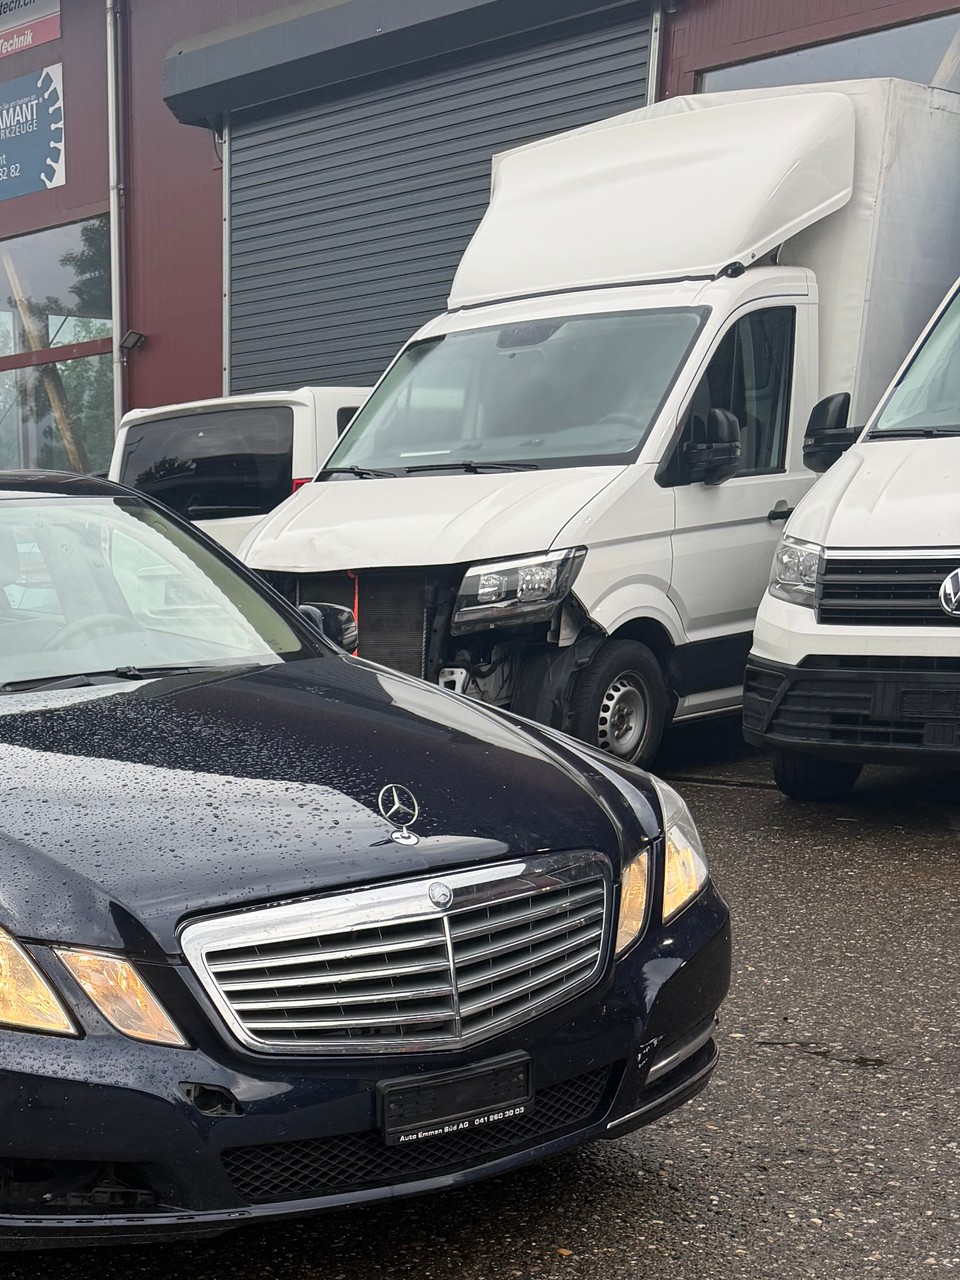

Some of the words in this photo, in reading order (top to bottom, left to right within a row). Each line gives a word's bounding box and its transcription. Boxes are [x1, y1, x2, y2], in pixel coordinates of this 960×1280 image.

[10, 163, 21, 177] 82
[399, 1133, 417, 1143] Auto
[418, 1128, 443, 1139] Emmen
[458, 1121, 469, 1130] AG
[474, 1117, 489, 1126] 041
